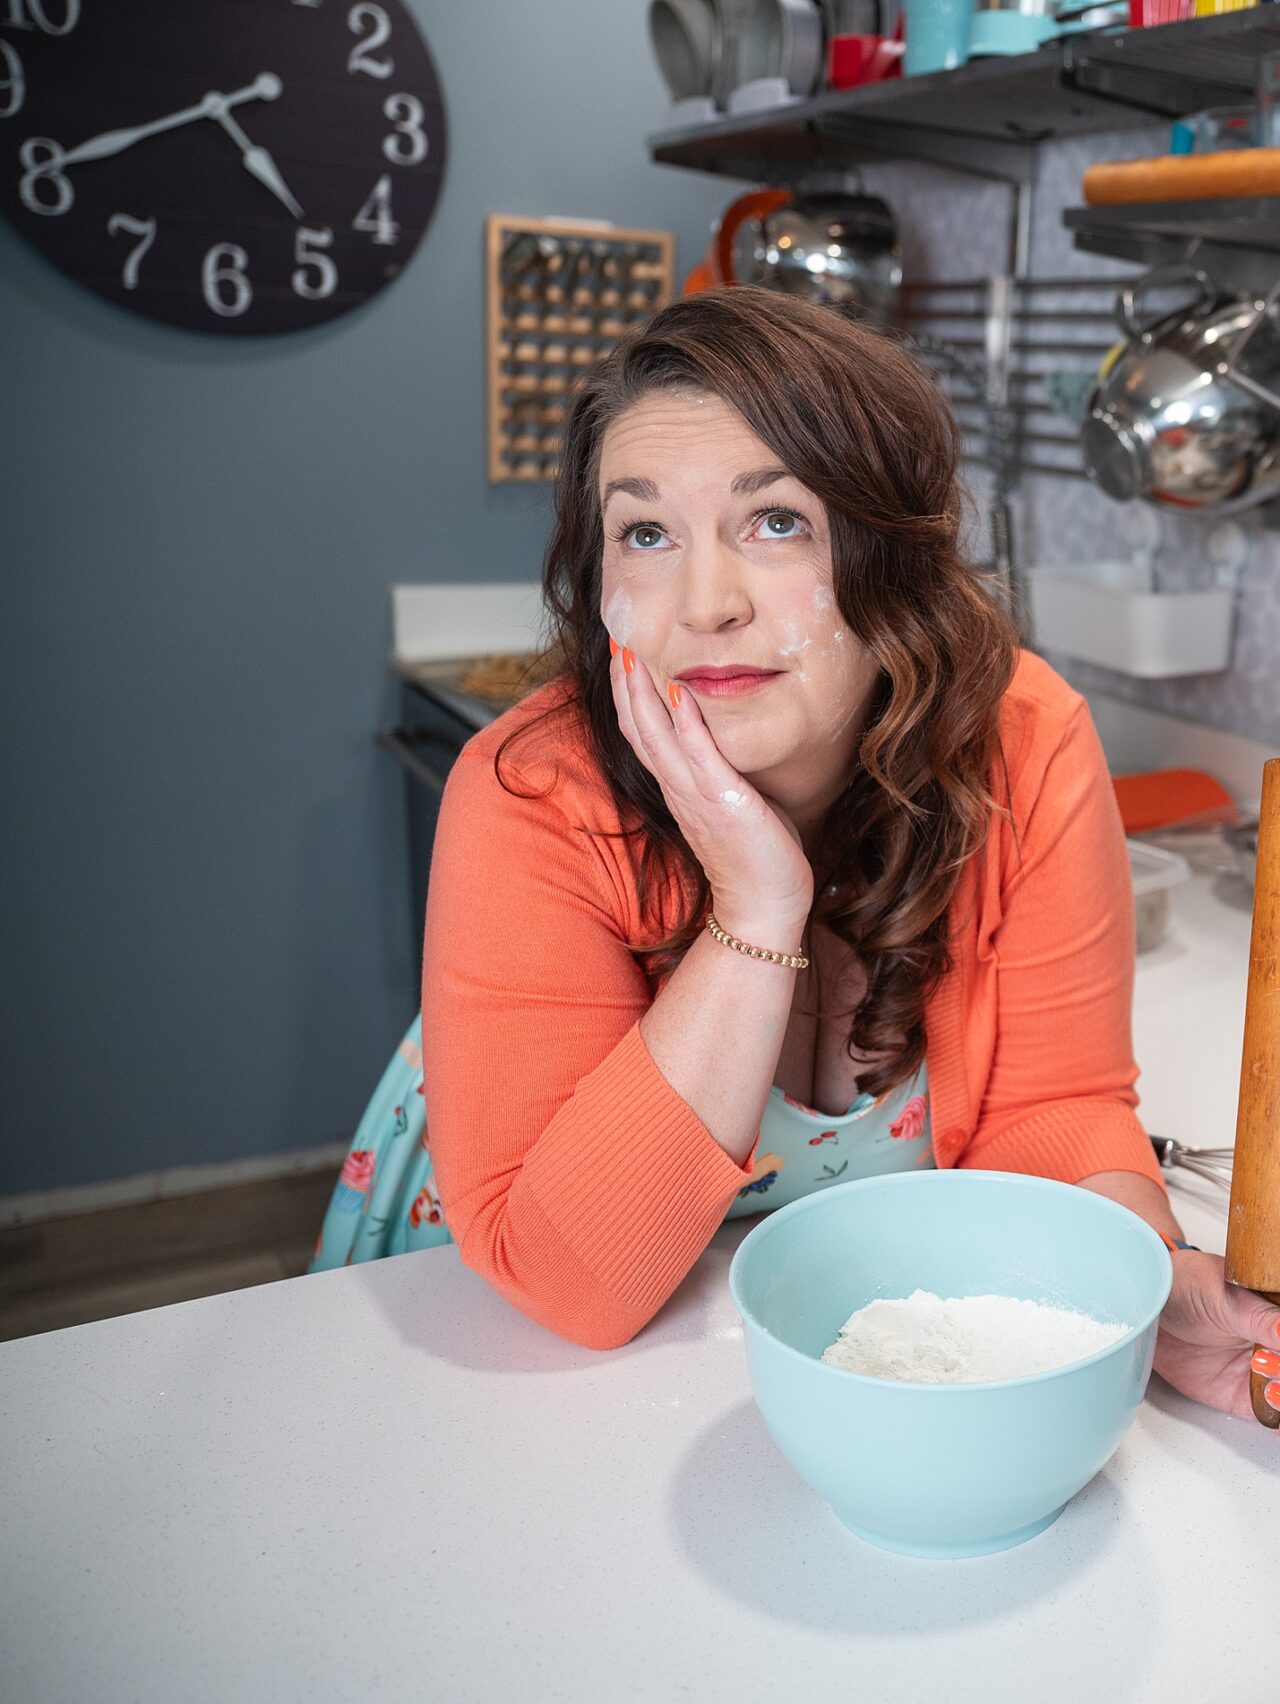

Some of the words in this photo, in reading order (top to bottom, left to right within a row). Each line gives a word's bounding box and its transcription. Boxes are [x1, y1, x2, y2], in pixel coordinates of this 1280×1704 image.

[347, 3, 395, 79] 2
[382, 92, 429, 166] 3
[19, 136, 75, 216] 8
[352, 173, 400, 246] 4
[108, 213, 156, 290] 7
[202, 242, 253, 318] 6
[292, 226, 339, 300] 5
